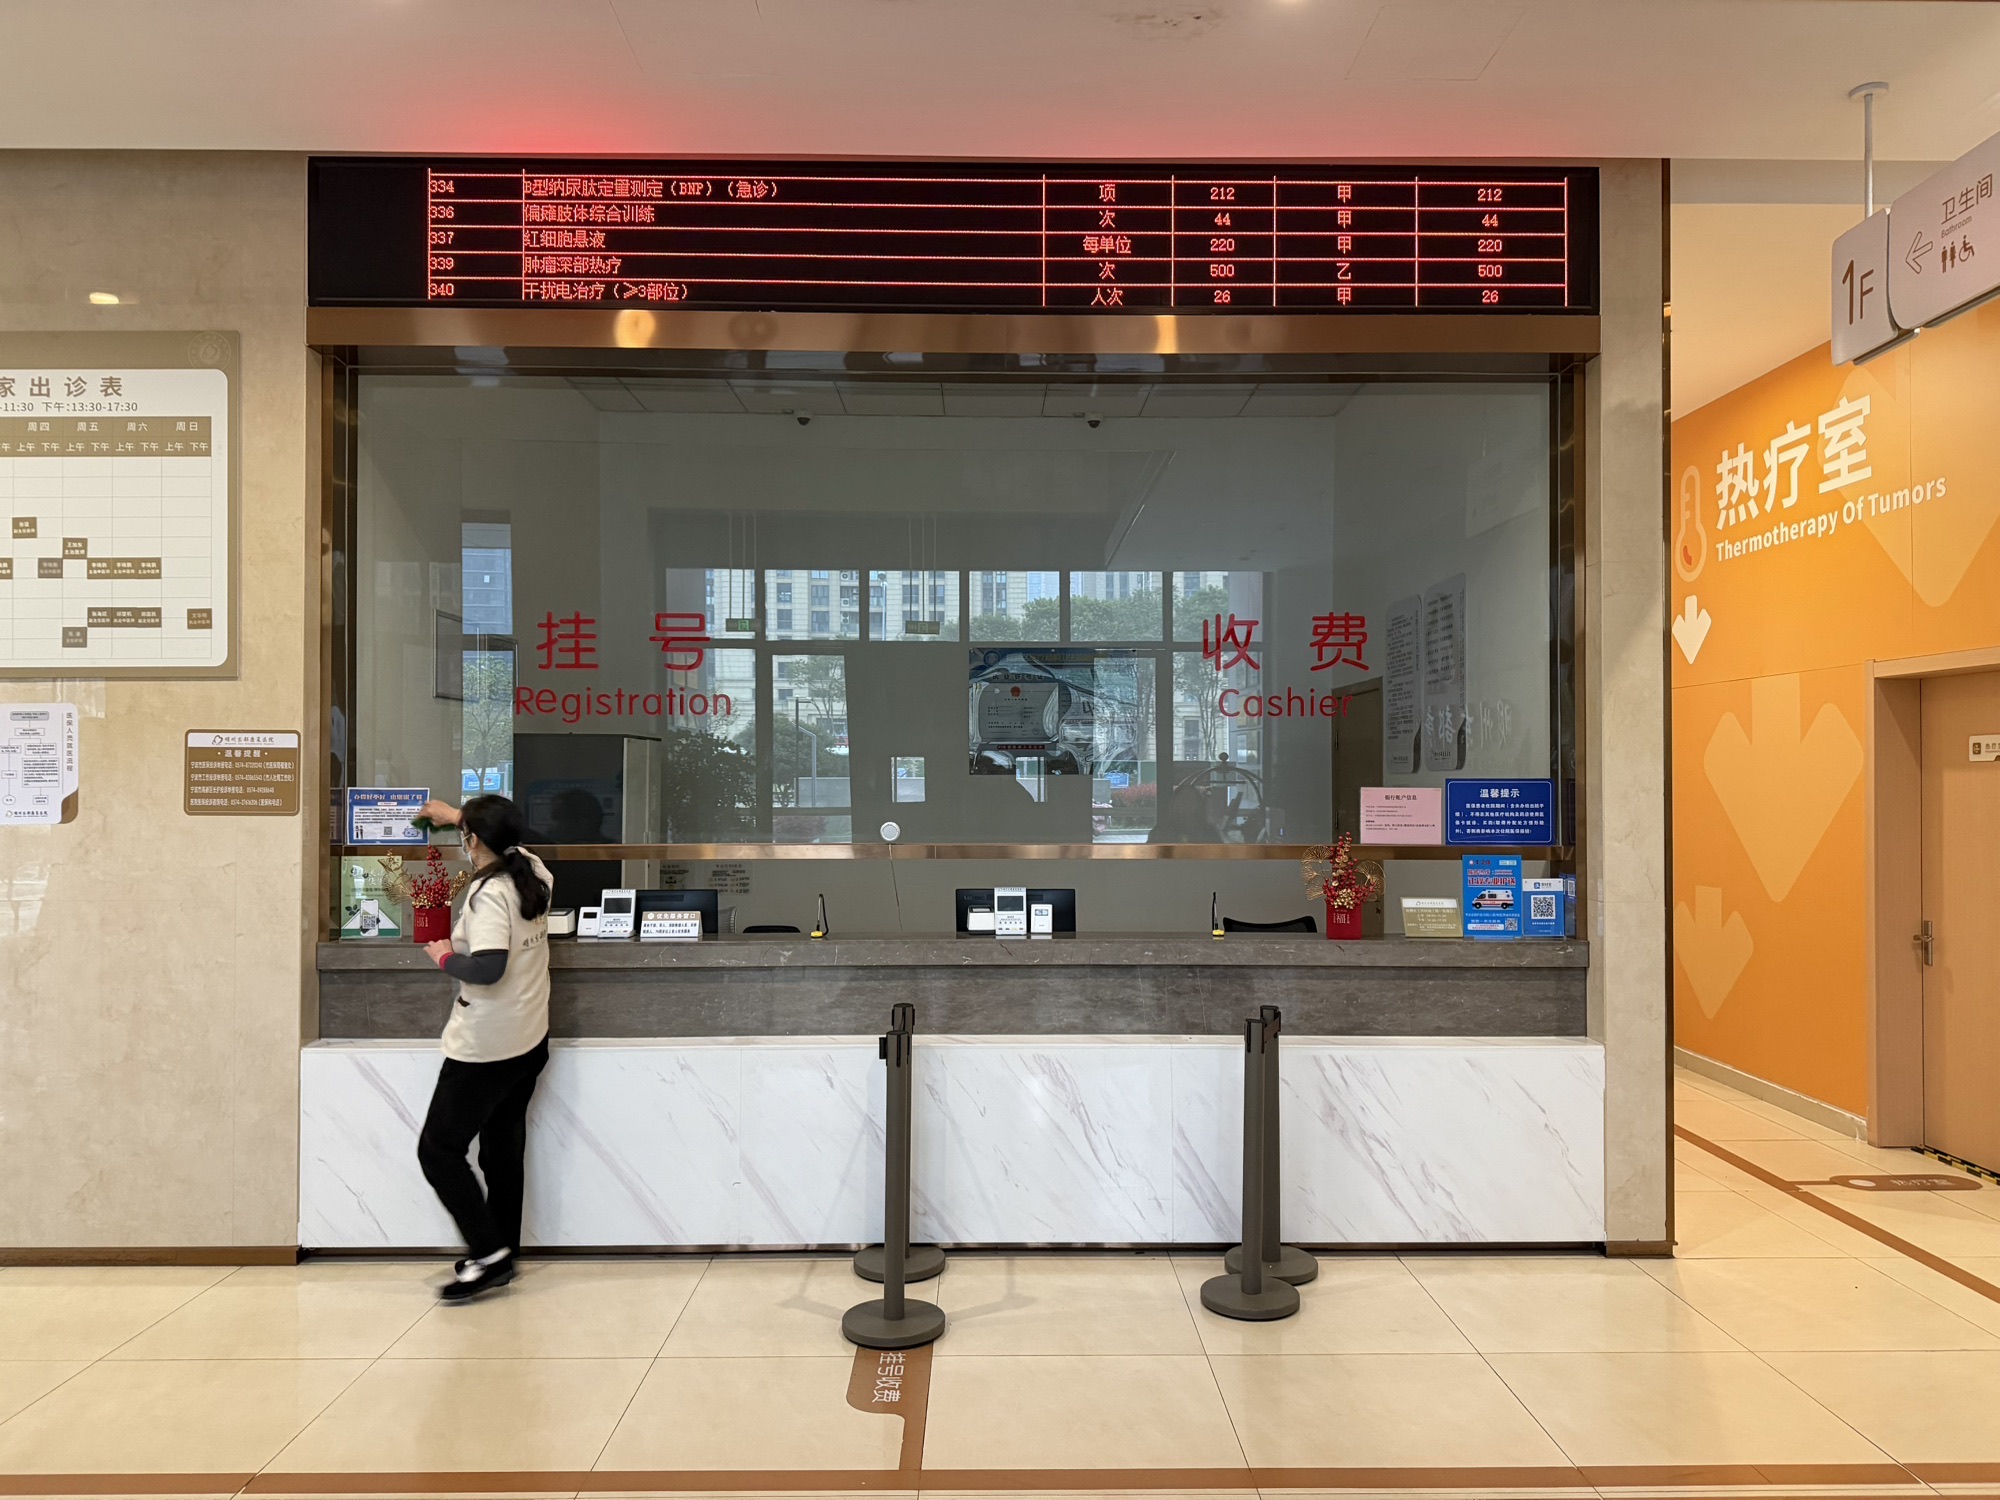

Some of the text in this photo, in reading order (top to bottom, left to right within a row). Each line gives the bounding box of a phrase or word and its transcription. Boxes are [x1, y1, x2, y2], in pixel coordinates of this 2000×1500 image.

[430, 180, 454, 193] 334
[1099, 184, 1116, 202] 项
[1210, 187, 1235, 200] 212
[1337, 185, 1351, 203] 甲
[1477, 188, 1502, 201] 212
[1941, 173, 1993, 225] 卫生间
[430, 206, 454, 219] 336
[1099, 210, 1116, 228] 次
[1214, 213, 1231, 226] 44
[1337, 211, 1351, 228] 甲
[1481, 214, 1499, 227] 44
[1940, 216, 1973, 239] Bathroom
[430, 230, 1502, 254] 337 红细胞悬液 每单位 220 甲 220
[430, 256, 1502, 280] 339 肿瘤深部热疗 次 500 乙 500
[430, 283, 454, 296] 340
[1090, 287, 1124, 306] 人次
[1213, 290, 1231, 303] 26
[1337, 287, 1351, 306] 甲
[1482, 290, 1499, 303] 26
[1842, 259, 1874, 326] 1F
[27, 422, 198, 432] 周四 周五 周六 周日
[16, 442, 36, 452] 上午
[41, 442, 60, 452] 下午
[65, 442, 85, 452] 上午
[90, 442, 110, 452] 下午
[115, 442, 135, 452] 上午
[140, 442, 159, 452] 下午
[164, 442, 184, 452] 上午
[189, 442, 209, 452] 下午
[1715, 394, 1873, 531] 热疗室
[1716, 477, 1947, 562] Thermotherapy Of Tumors
[536, 610, 711, 671] 挂号
[1202, 611, 1369, 671] 收费
[515, 686, 732, 724] Registration
[1218, 686, 1353, 718] Cashier
[1479, 788, 1520, 798] 温馨提示
